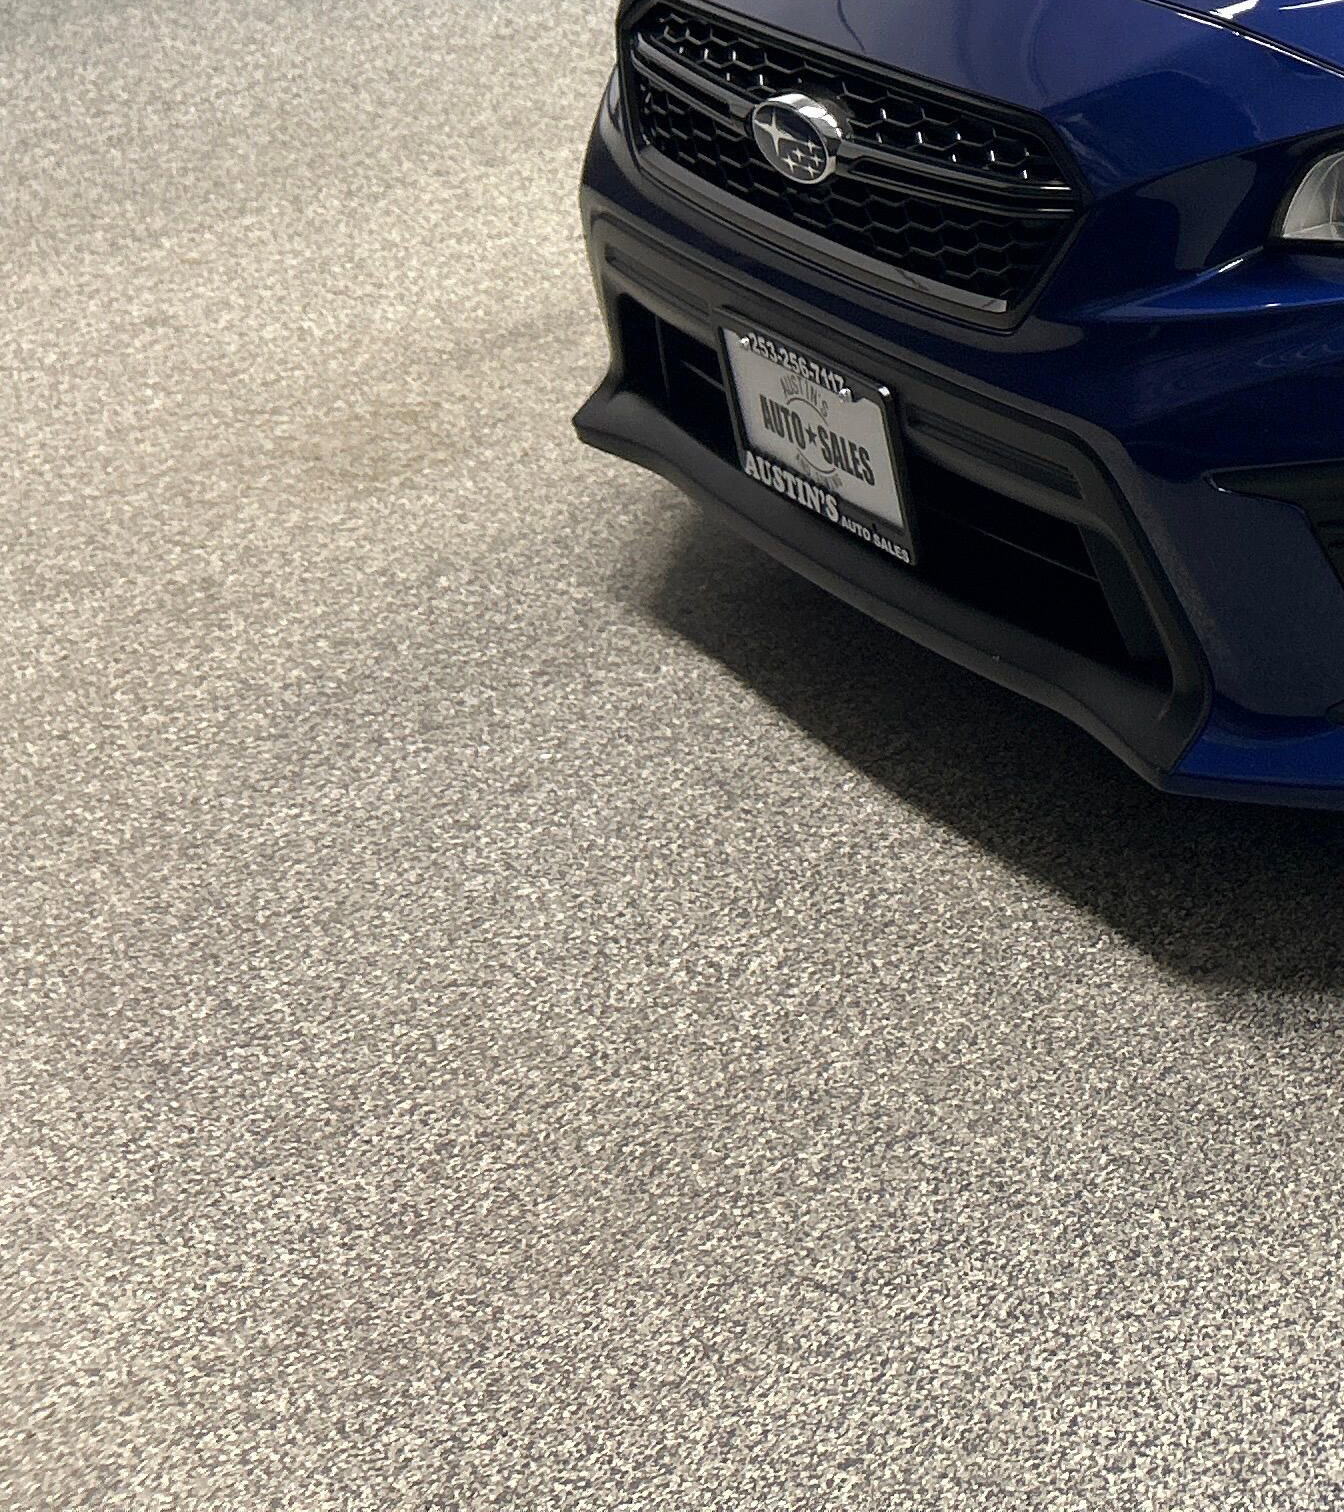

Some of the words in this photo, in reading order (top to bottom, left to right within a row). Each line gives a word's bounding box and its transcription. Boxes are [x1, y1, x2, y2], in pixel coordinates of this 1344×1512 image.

[750, 332, 845, 394] 253-256-7117
[760, 394, 806, 449] AUTO
[817, 423, 875, 486] SALES
[745, 450, 839, 524] AUSTIN'S
[840, 515, 872, 541] AUTO
[872, 533, 910, 565] SALES
